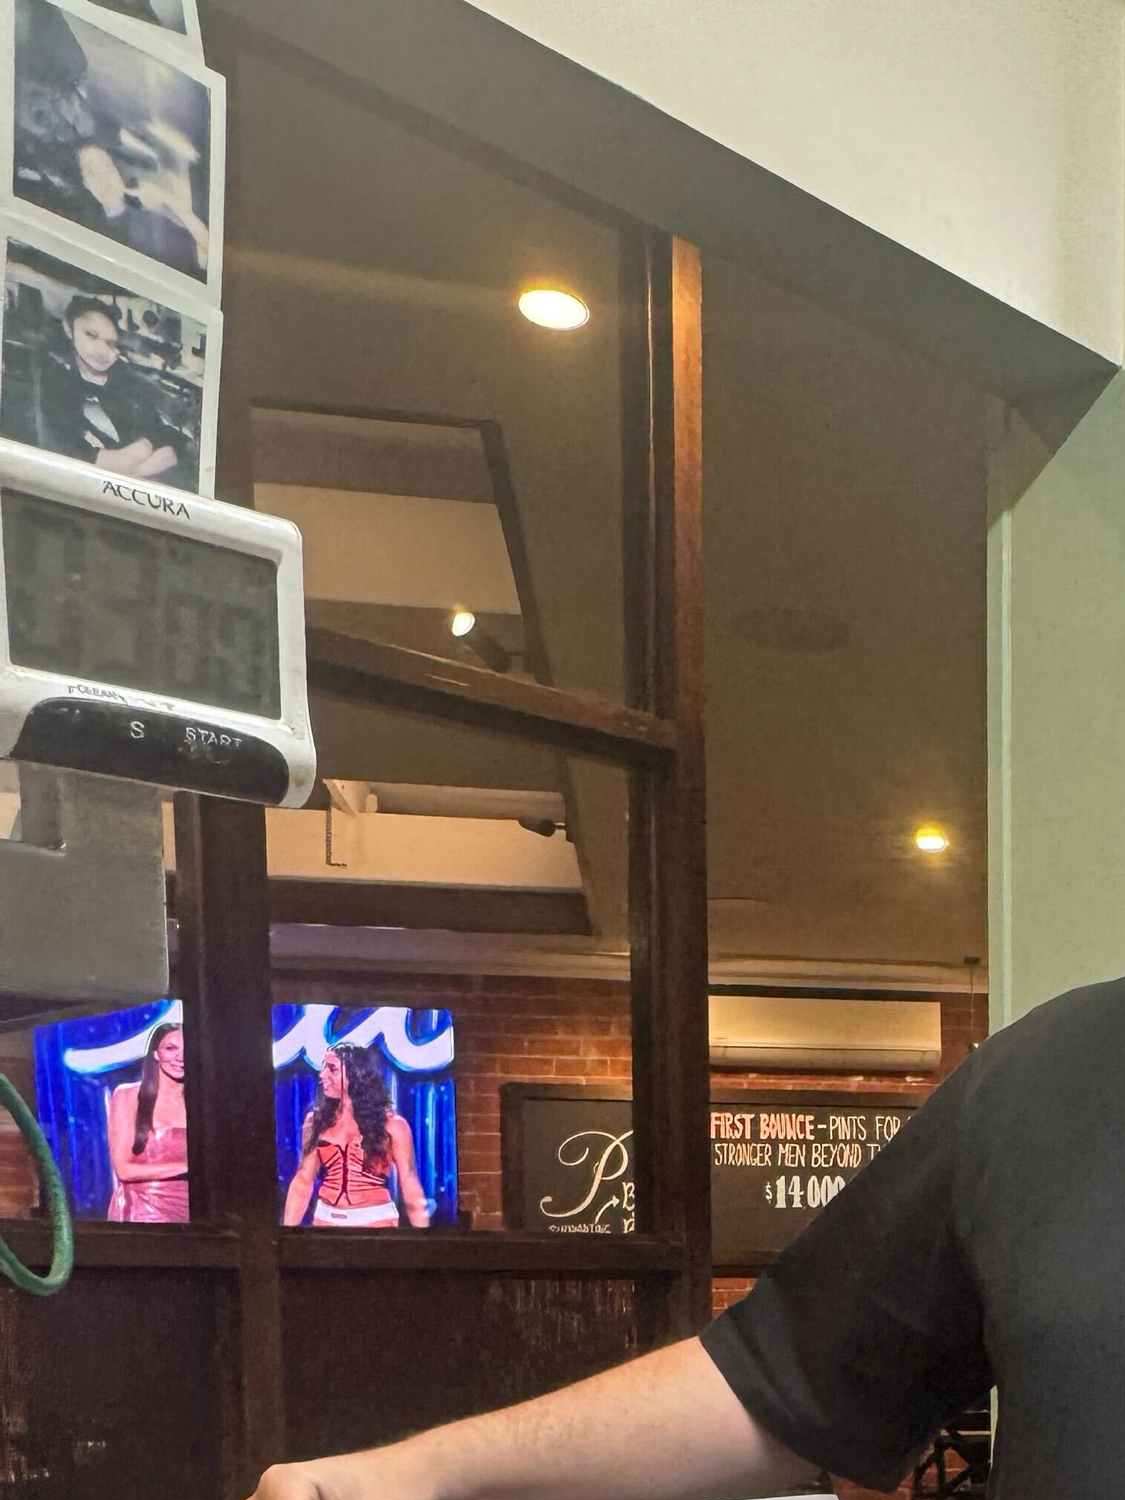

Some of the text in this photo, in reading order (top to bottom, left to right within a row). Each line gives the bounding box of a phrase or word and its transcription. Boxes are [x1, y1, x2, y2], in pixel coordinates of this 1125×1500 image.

[102, 480, 191, 520] ACCURA
[710, 1112, 756, 1140] FIRST
[760, 1112, 815, 1141] BOUNCE
[829, 1115, 867, 1141] PINTS
[714, 1143, 772, 1167] STRONGER
[777, 1143, 806, 1168] MEN
[811, 1142, 862, 1168] BEYOND
